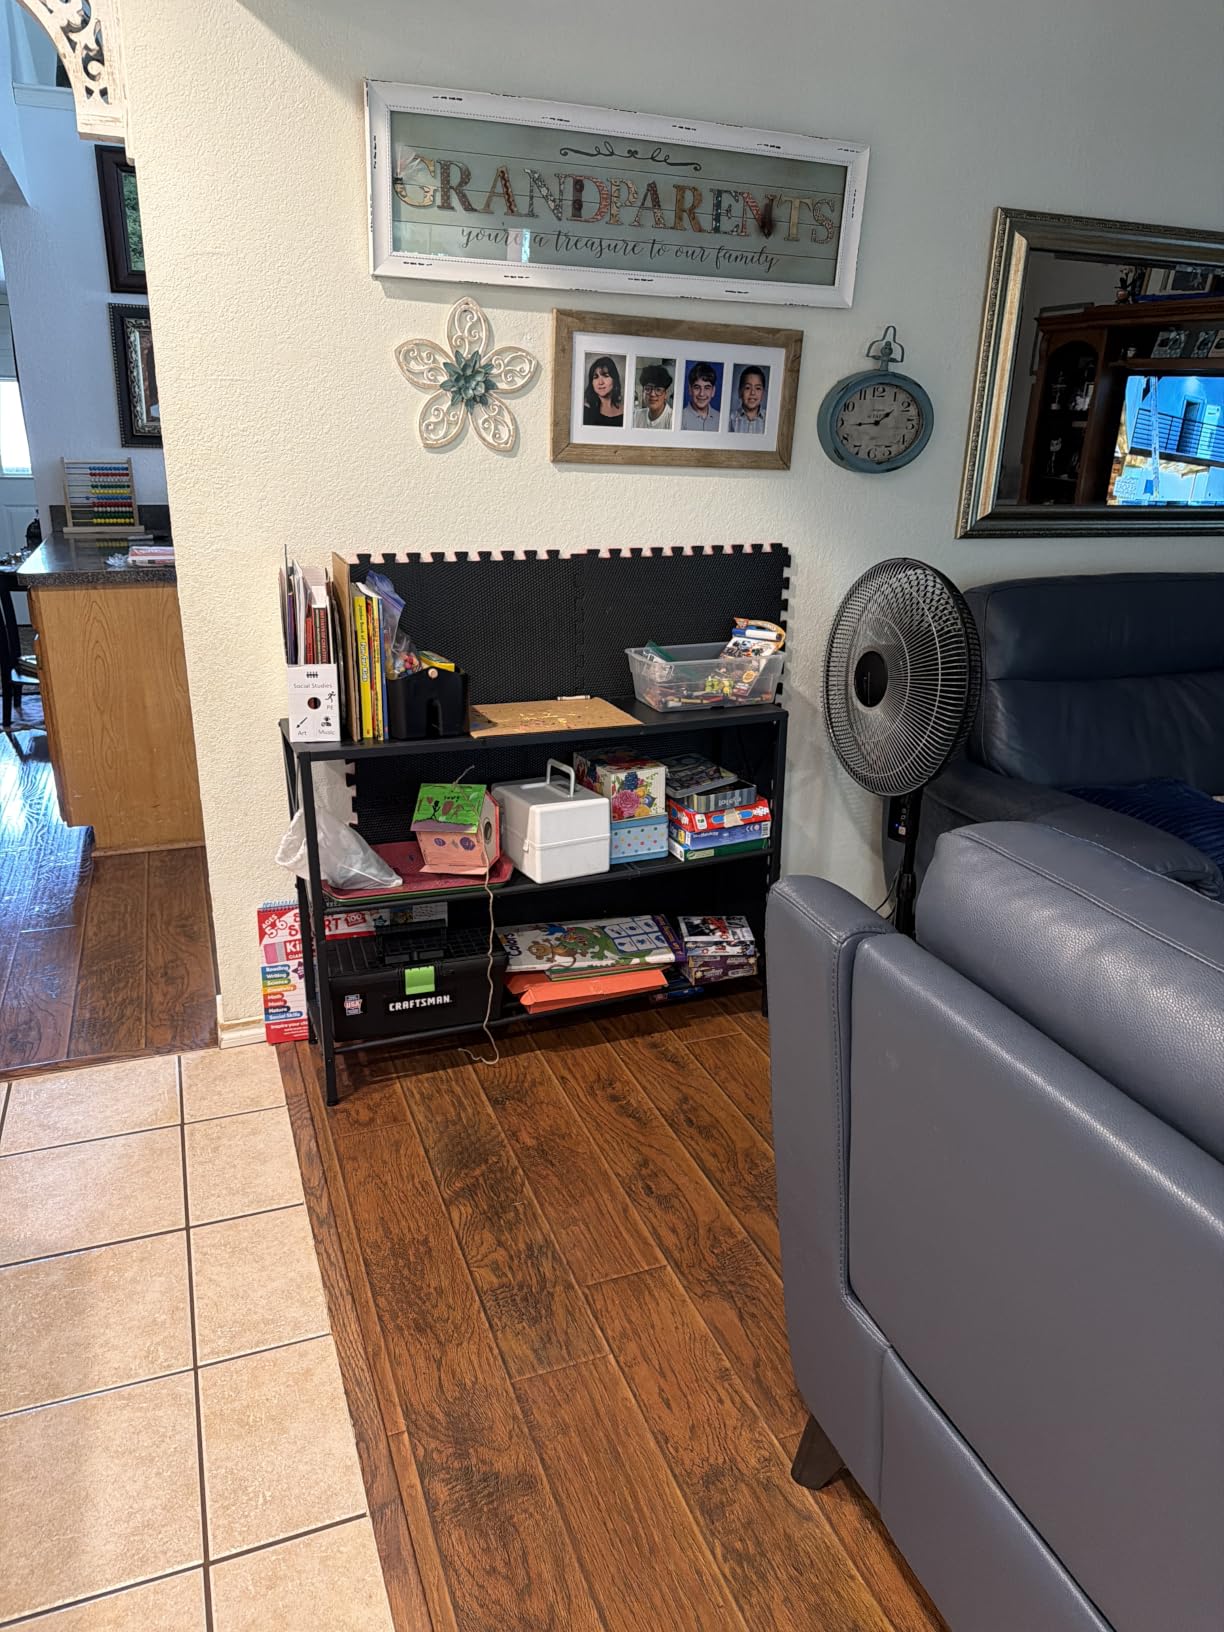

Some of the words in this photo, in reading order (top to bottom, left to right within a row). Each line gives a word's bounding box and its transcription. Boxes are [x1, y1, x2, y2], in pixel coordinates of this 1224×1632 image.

[392, 153, 835, 245] GRANDPARENTS
[533, 232, 548, 248] a
[551, 230, 644, 259] treasure
[649, 238, 667, 260] to
[674, 245, 710, 263] our
[715, 245, 780, 273] family
[859, 388, 867, 401] 11
[872, 386, 886, 398] 12
[843, 400, 856, 412] 10
[900, 400, 911, 413] 2
[905, 418, 915, 431] 3
[867, 447, 878, 459] 6
[262, 914, 278, 929] AGES
[264, 919, 288, 938] 5-6
[388, 994, 451, 1012] CRAFTSMAN
